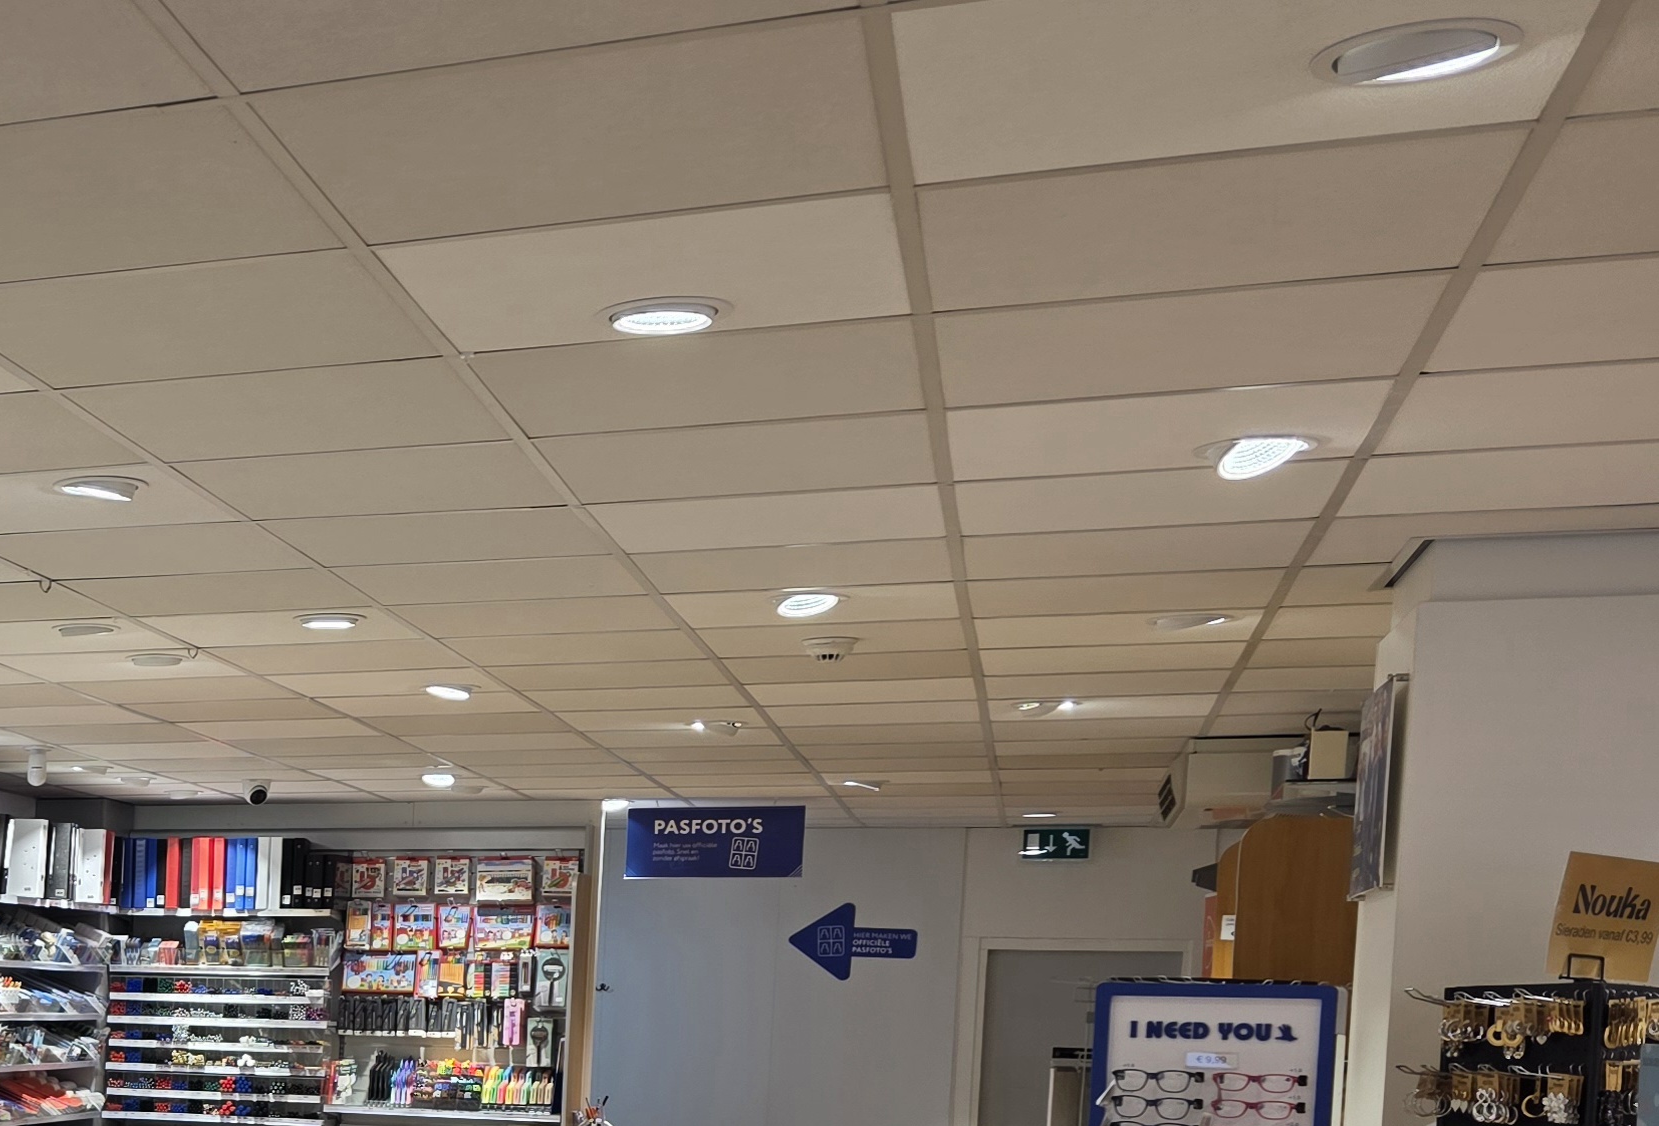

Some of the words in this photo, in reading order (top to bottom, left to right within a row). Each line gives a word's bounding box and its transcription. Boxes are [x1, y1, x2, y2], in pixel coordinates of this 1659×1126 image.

[654, 819, 763, 834] PASFOTO'S
[1573, 883, 1651, 921] Nouka
[1555, 923, 1597, 939] Sieraden
[1597, 928, 1624, 941] vanaf
[1625, 929, 1654, 945] €3,99
[1129, 1020, 1138, 1039] I
[1146, 1020, 1210, 1040] NEED
[1218, 1022, 1272, 1042] YOU
